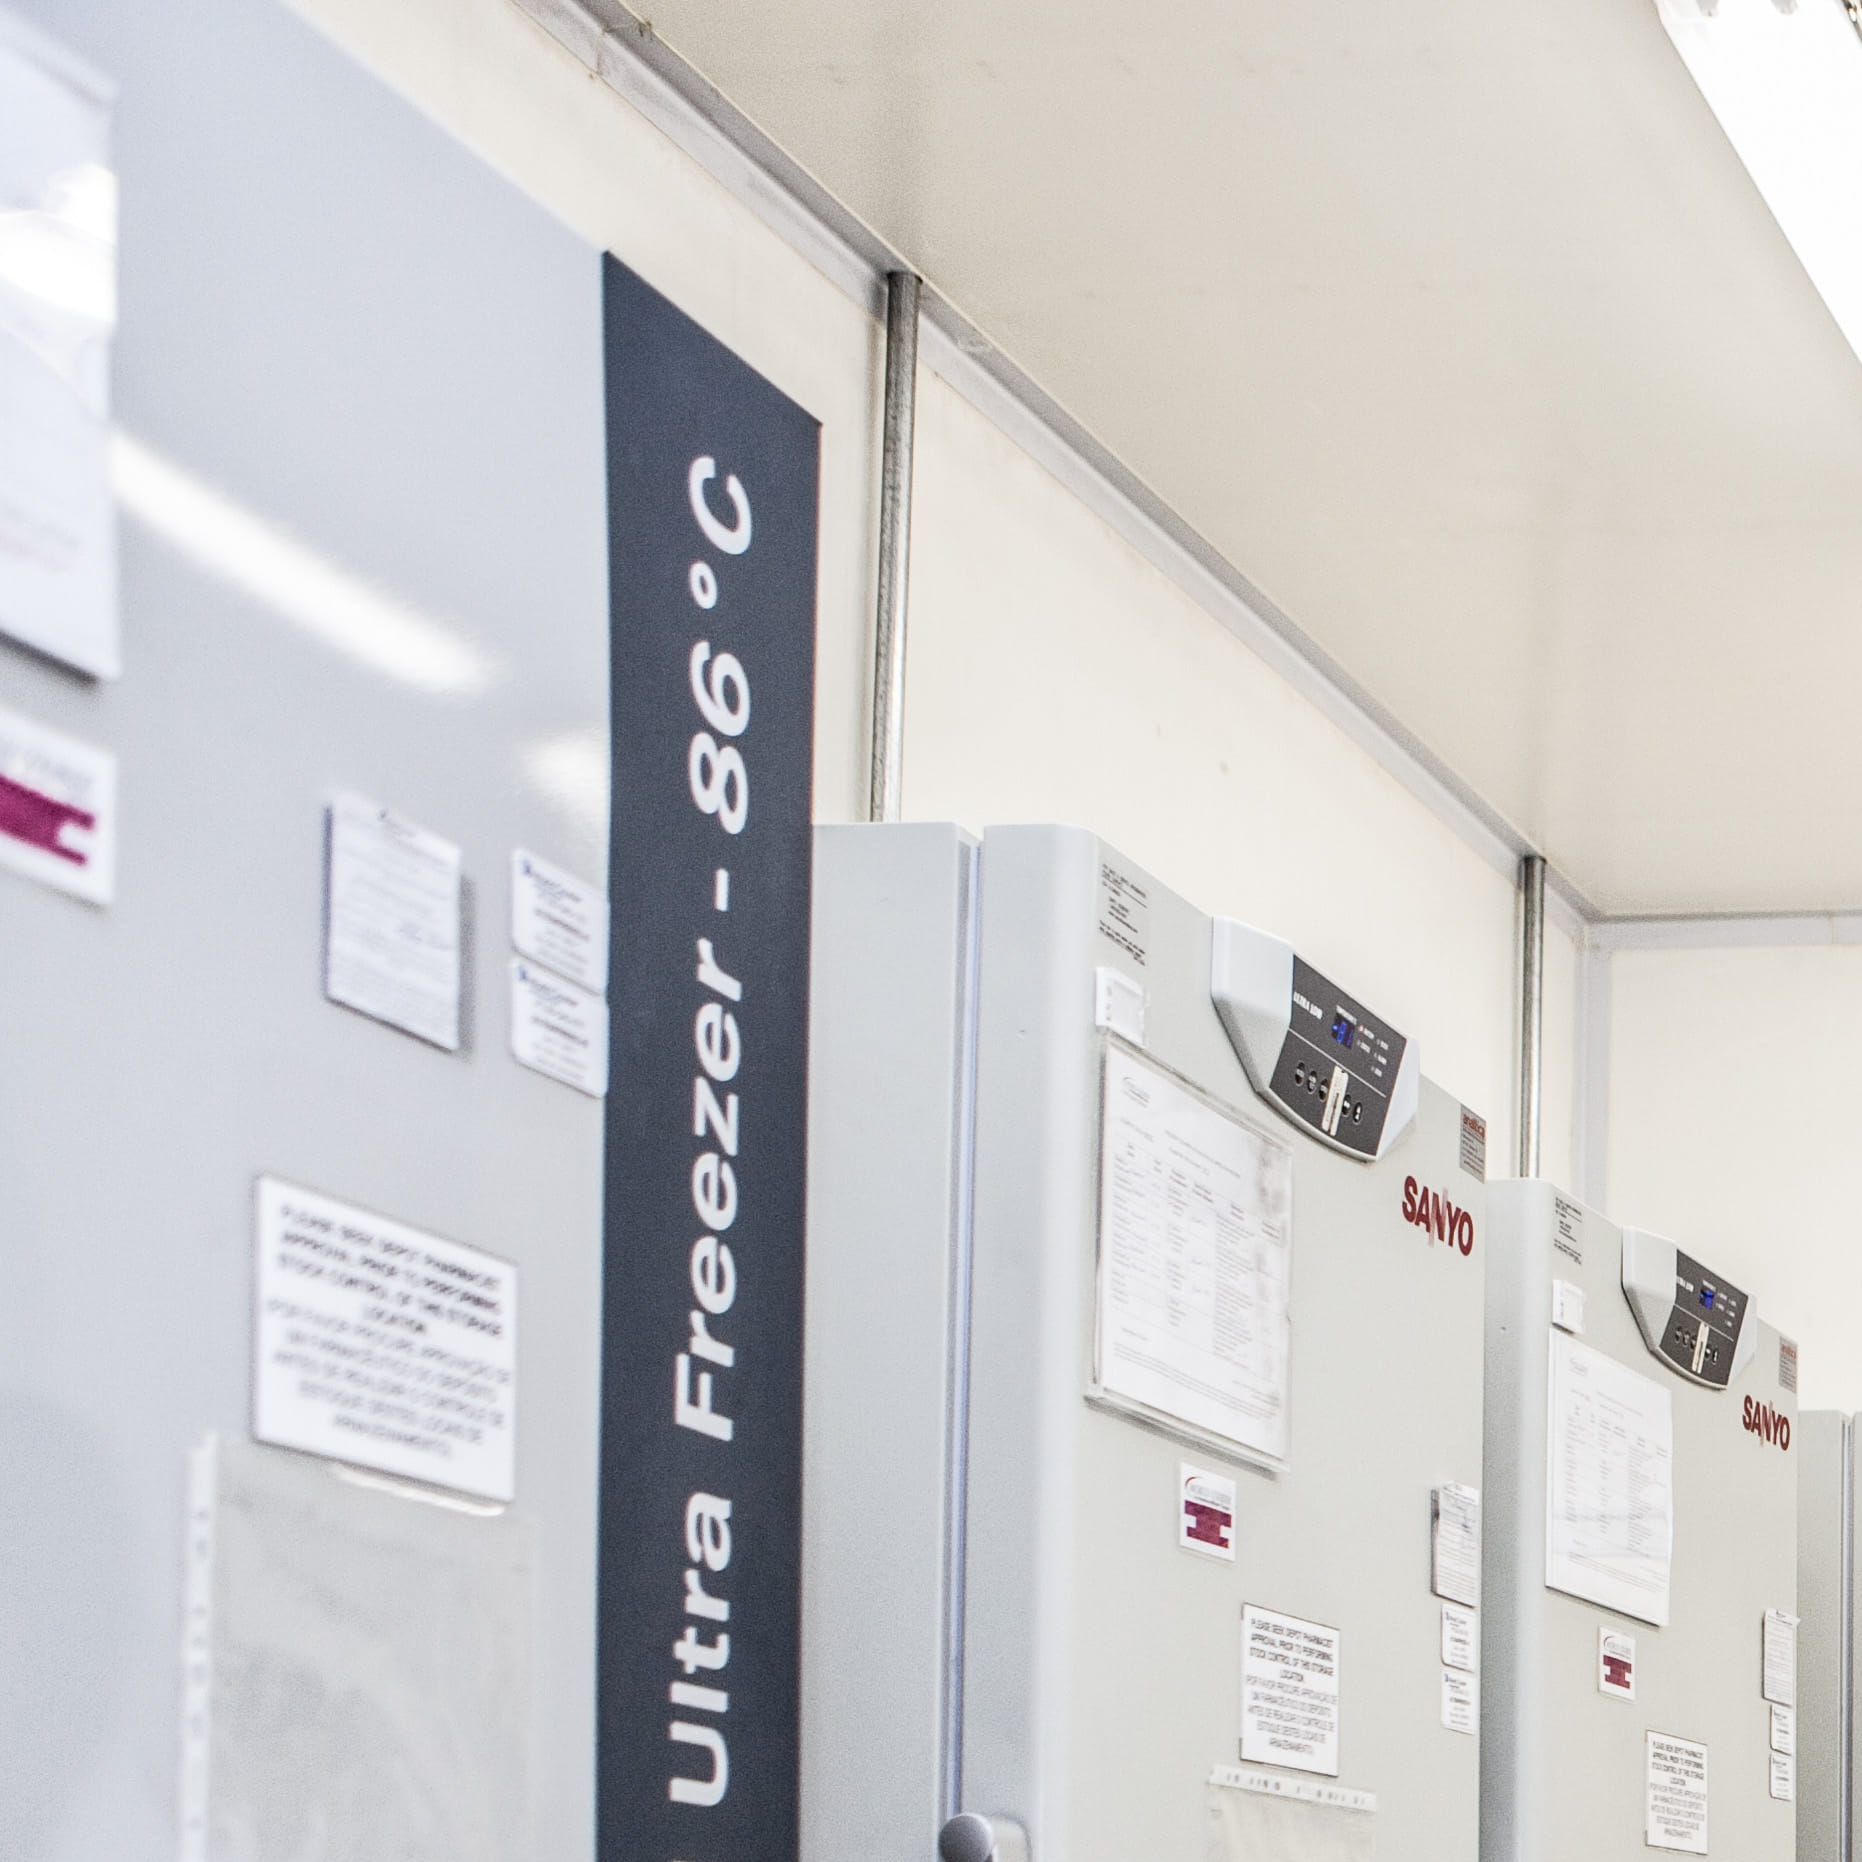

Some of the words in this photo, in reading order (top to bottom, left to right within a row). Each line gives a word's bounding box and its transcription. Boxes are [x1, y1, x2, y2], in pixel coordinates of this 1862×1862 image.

[674, 939, 743, 1441] Freezer
[1401, 1176, 1475, 1257] SANYO
[1741, 1394, 1791, 1451] SANYO
[668, 1490, 733, 1807] Ultra
